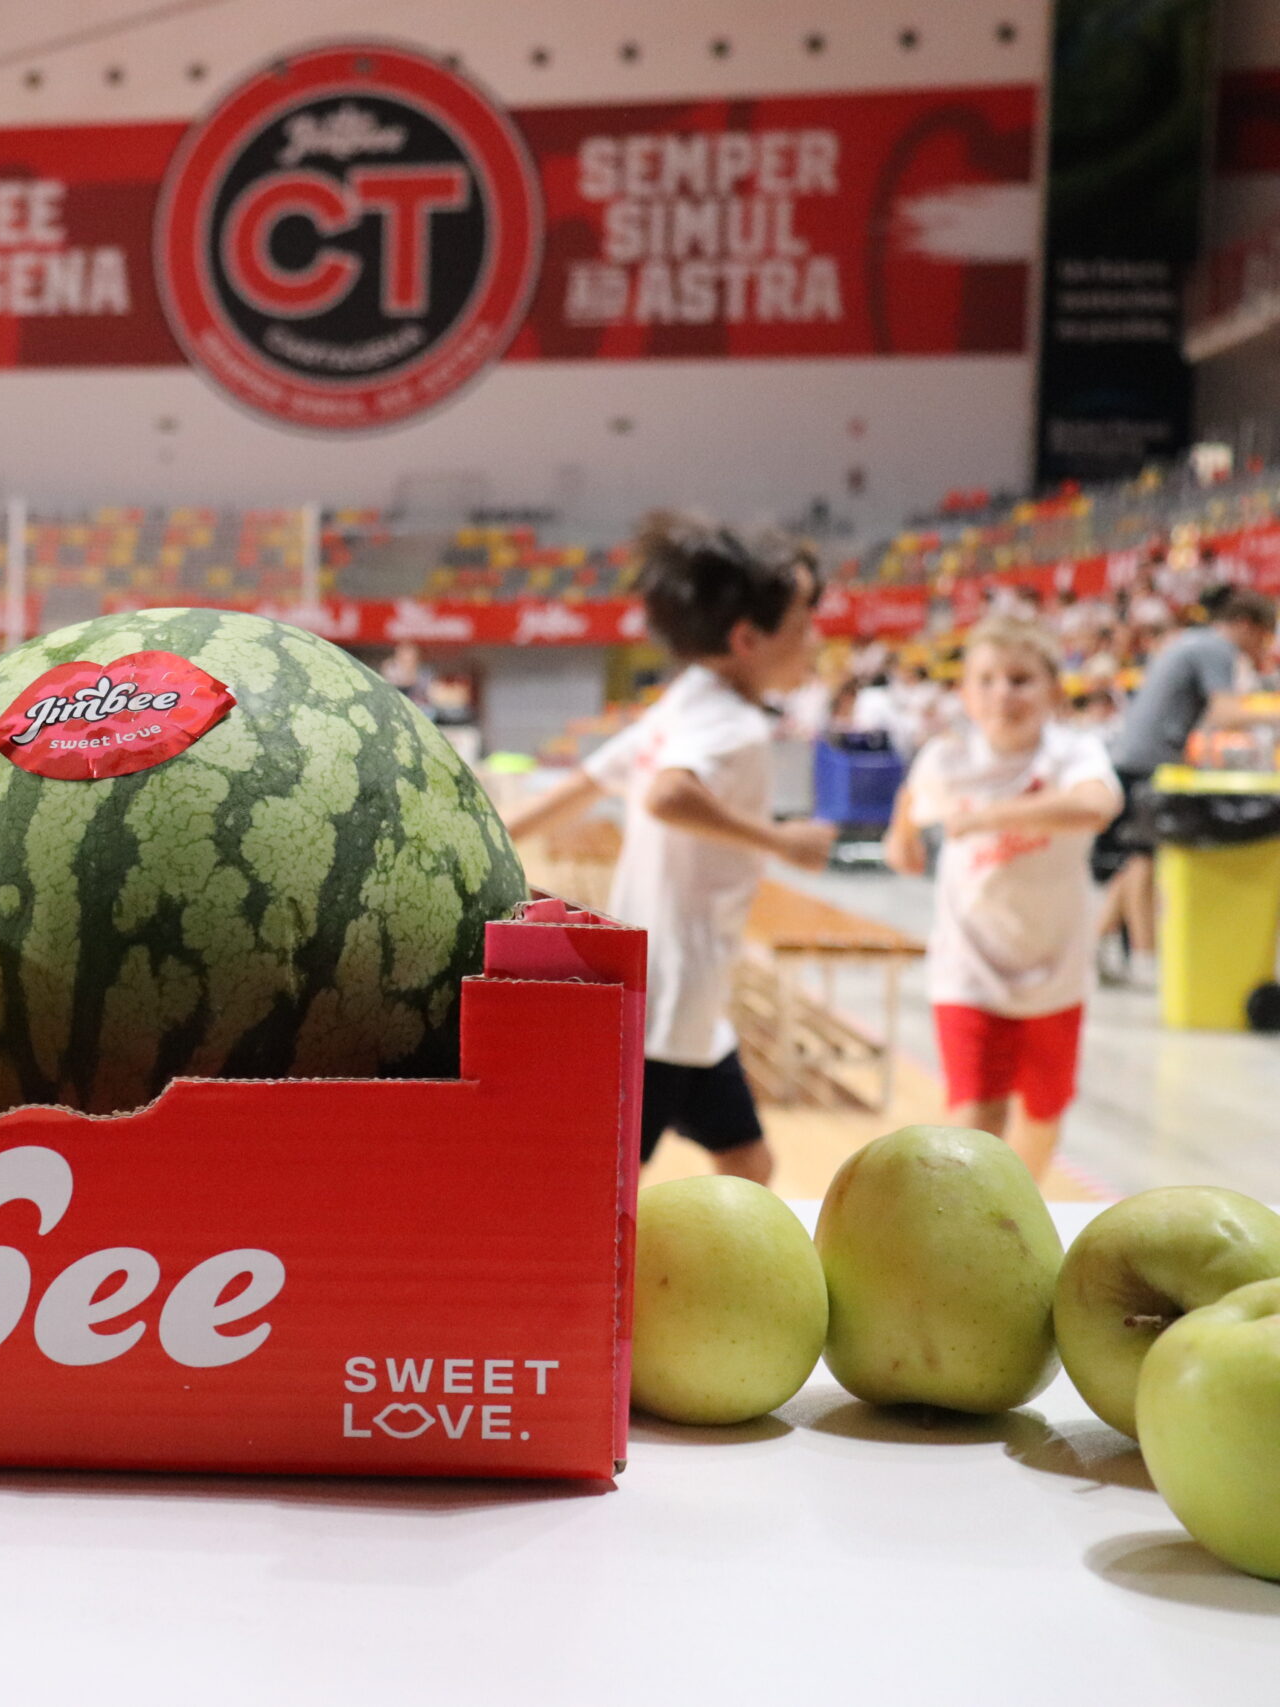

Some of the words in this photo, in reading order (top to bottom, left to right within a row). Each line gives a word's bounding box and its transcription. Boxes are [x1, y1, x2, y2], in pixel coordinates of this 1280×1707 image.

[577, 130, 840, 200] SEMPER
[221, 162, 469, 320] CT
[603, 197, 809, 262] SIMUL
[633, 254, 842, 325] ASTRA
[9, 674, 180, 746] Jimbee
[49, 734, 110, 750] sweet
[116, 723, 162, 745] love
[343, 1355, 560, 1395] SWEET
[342, 1402, 530, 1439] LOVE.
